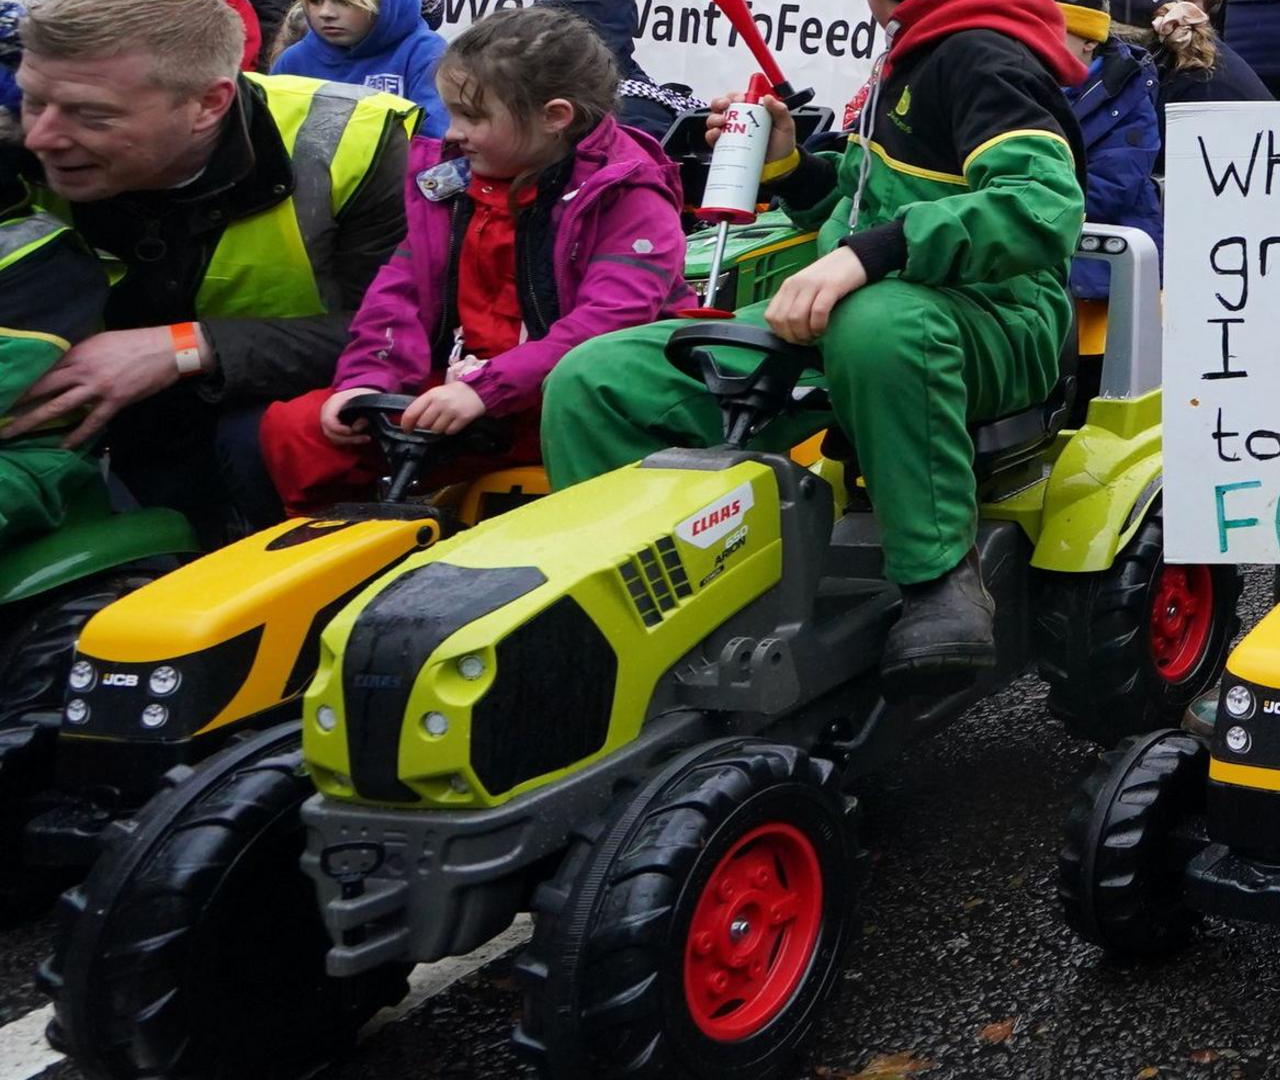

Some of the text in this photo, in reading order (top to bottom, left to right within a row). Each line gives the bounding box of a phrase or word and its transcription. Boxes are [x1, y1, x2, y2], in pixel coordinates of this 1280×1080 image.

[722, 123, 747, 134] RN
[1200, 318, 1249, 380] I
[691, 499, 741, 537] CLAAS
[102, 673, 139, 687] JCB
